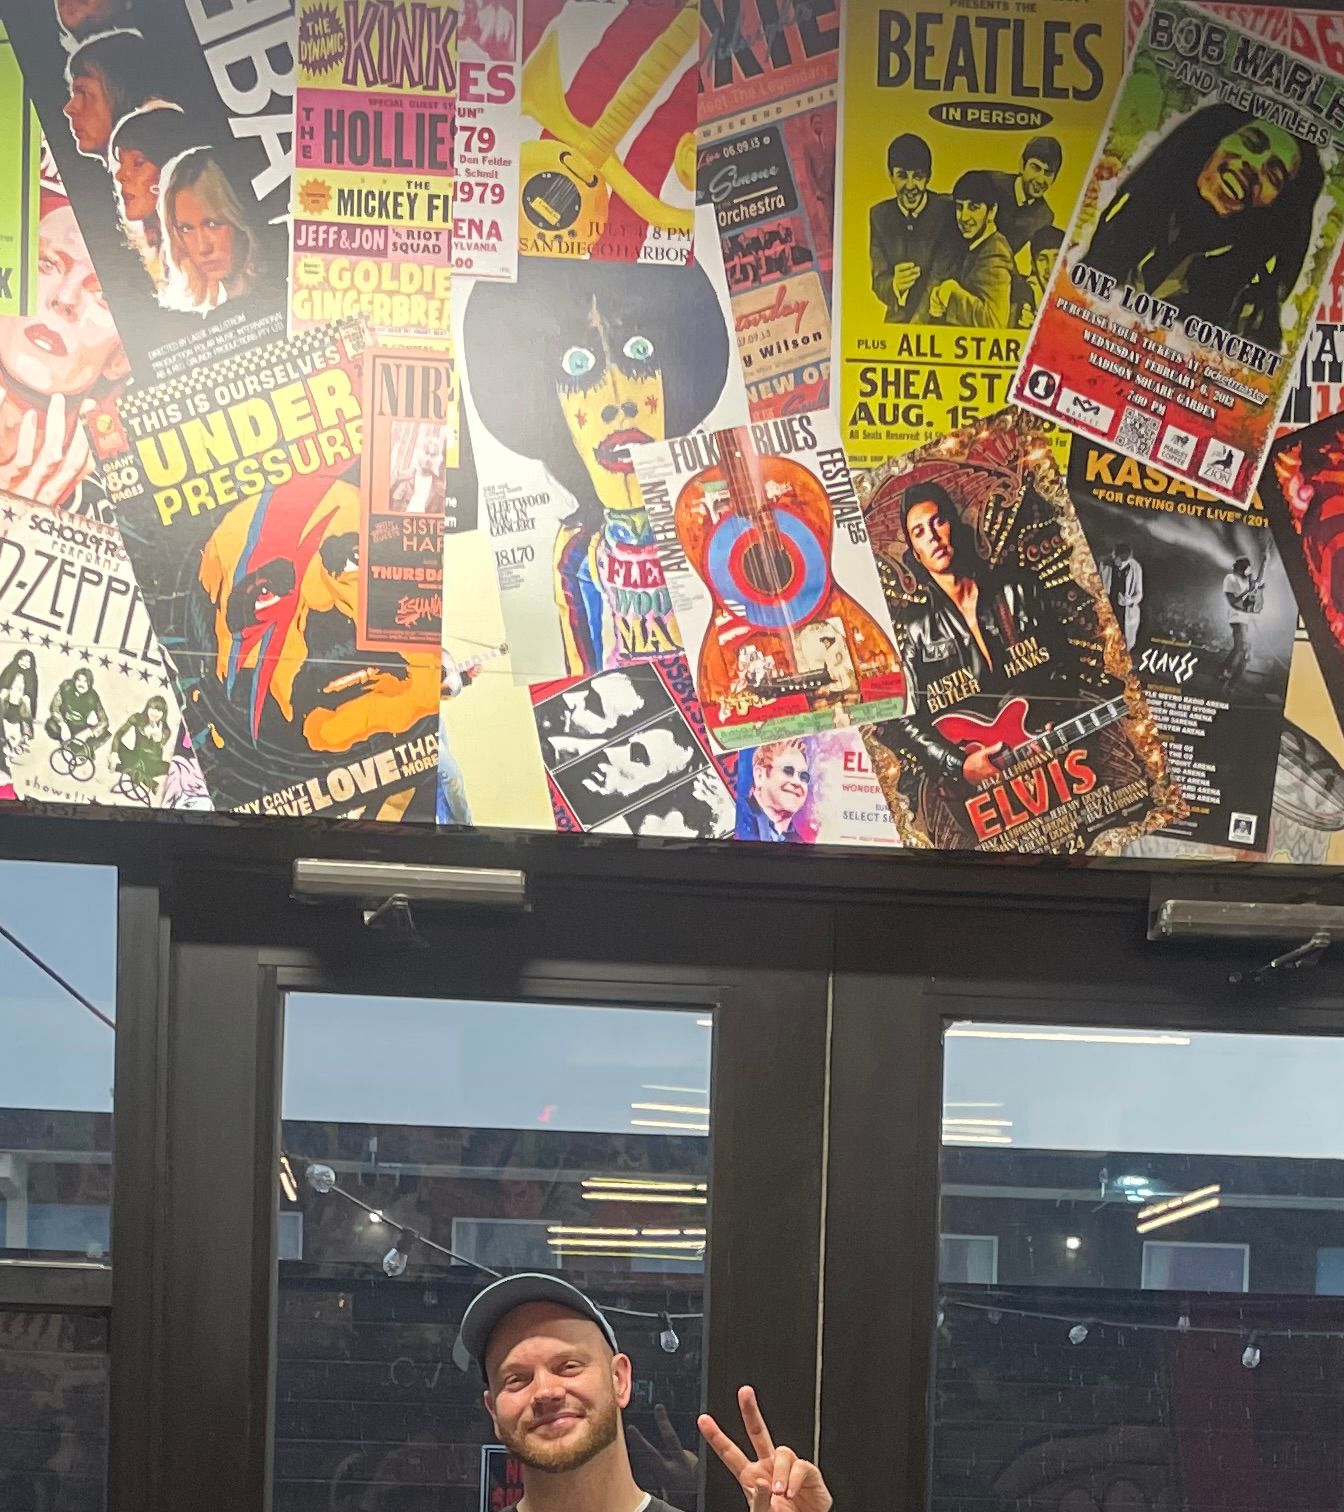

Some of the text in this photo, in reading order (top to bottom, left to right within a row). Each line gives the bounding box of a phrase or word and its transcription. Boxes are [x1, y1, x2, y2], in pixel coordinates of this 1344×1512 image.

[877, 9, 1105, 101] BEATLES
[1150, 11, 1228, 66] BOB
[941, 106, 1042, 126] IN PERSON
[1175, 61, 1330, 147] AND THE WAILERS
[336, 188, 423, 219] MICKEY
[718, 192, 786, 227] Orchestra
[760, 327, 824, 364] Wilson
[1057, 298, 1268, 402] PURCHASE YOUR TICKETS AT ticketmaster
[1069, 262, 1282, 378] ONE LOVE CONCERT
[859, 367, 946, 400] SHEA
[1082, 328, 1196, 390] WEDNESDAY FEBRUARY
[1088, 352, 1216, 419] MADISON SQUARE GARDEN
[129, 407, 182, 436] THIS
[186, 394, 209, 419] IS
[214, 345, 341, 407] OURSELVES
[134, 367, 362, 489] UNDER
[668, 416, 818, 475] FOLK BLUES
[816, 446, 860, 531] FESTIVAL
[641, 480, 690, 573] AMERICAN
[1003, 647, 1051, 680] HANKS
[1006, 638, 1040, 658] TOM
[926, 666, 974, 698] AUSTIN
[928, 678, 981, 714] BUTLER
[308, 744, 403, 810] LOVE
[965, 748, 1098, 837] ELVIS
